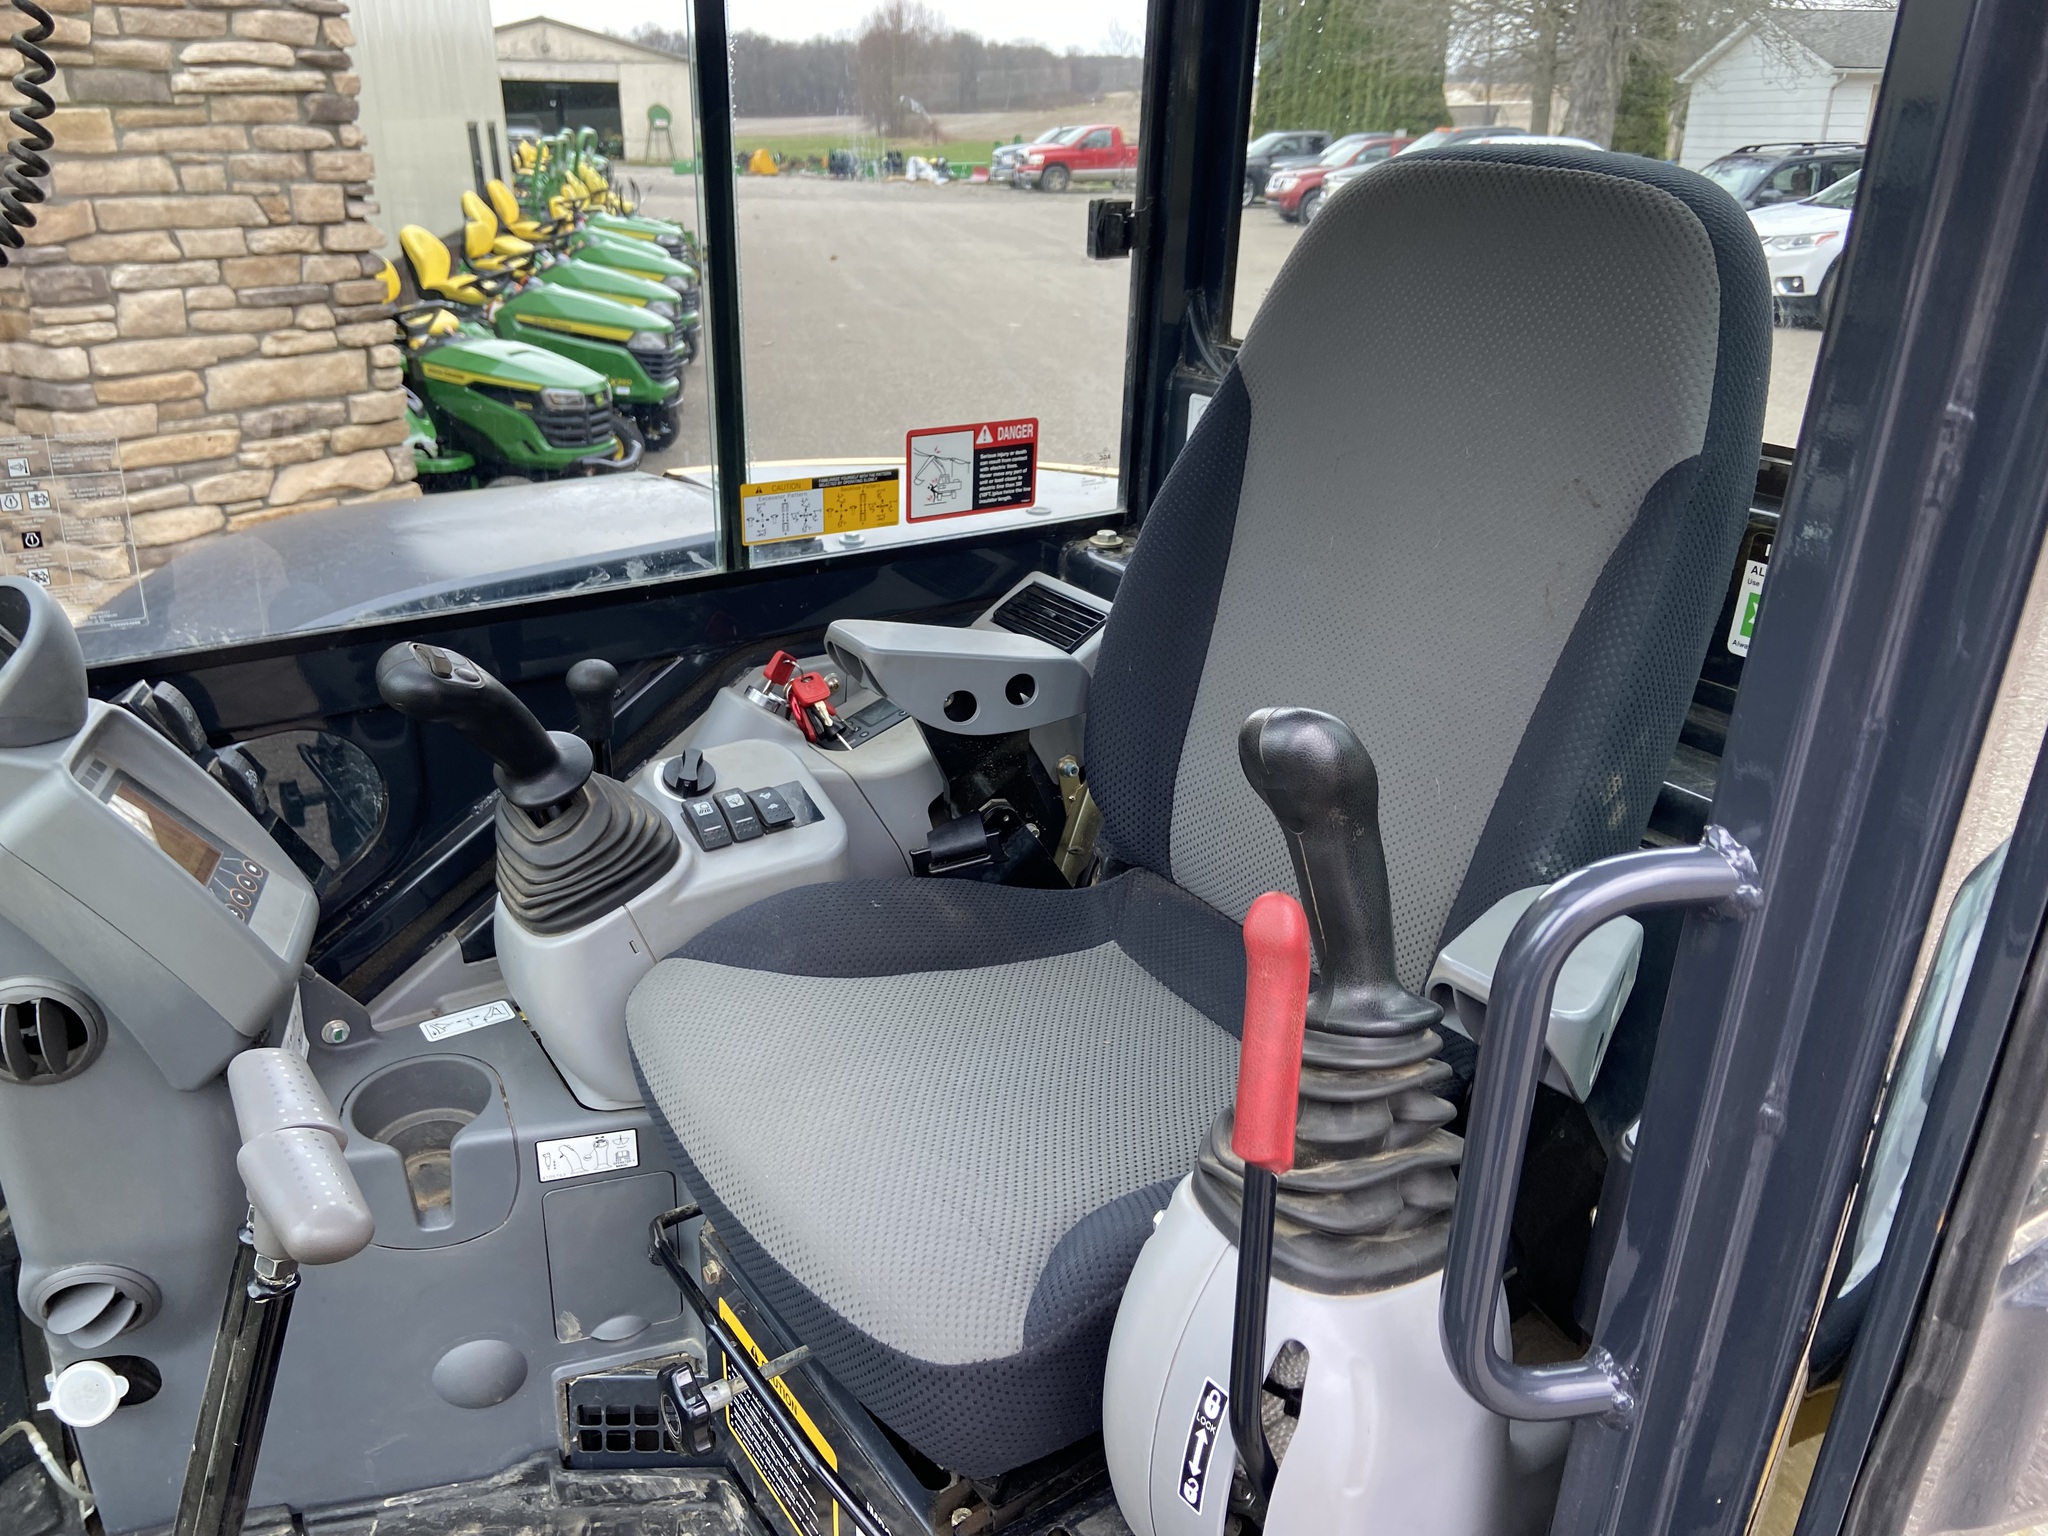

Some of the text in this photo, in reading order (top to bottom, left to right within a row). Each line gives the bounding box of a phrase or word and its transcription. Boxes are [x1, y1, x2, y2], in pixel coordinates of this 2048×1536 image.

[998, 423, 1034, 441] DANGER
[772, 482, 801, 492] CAUTION
[759, 494, 785, 502] Excavator
[1747, 578, 1760, 587] Use
[1196, 1411, 1216, 1435] LOCK
